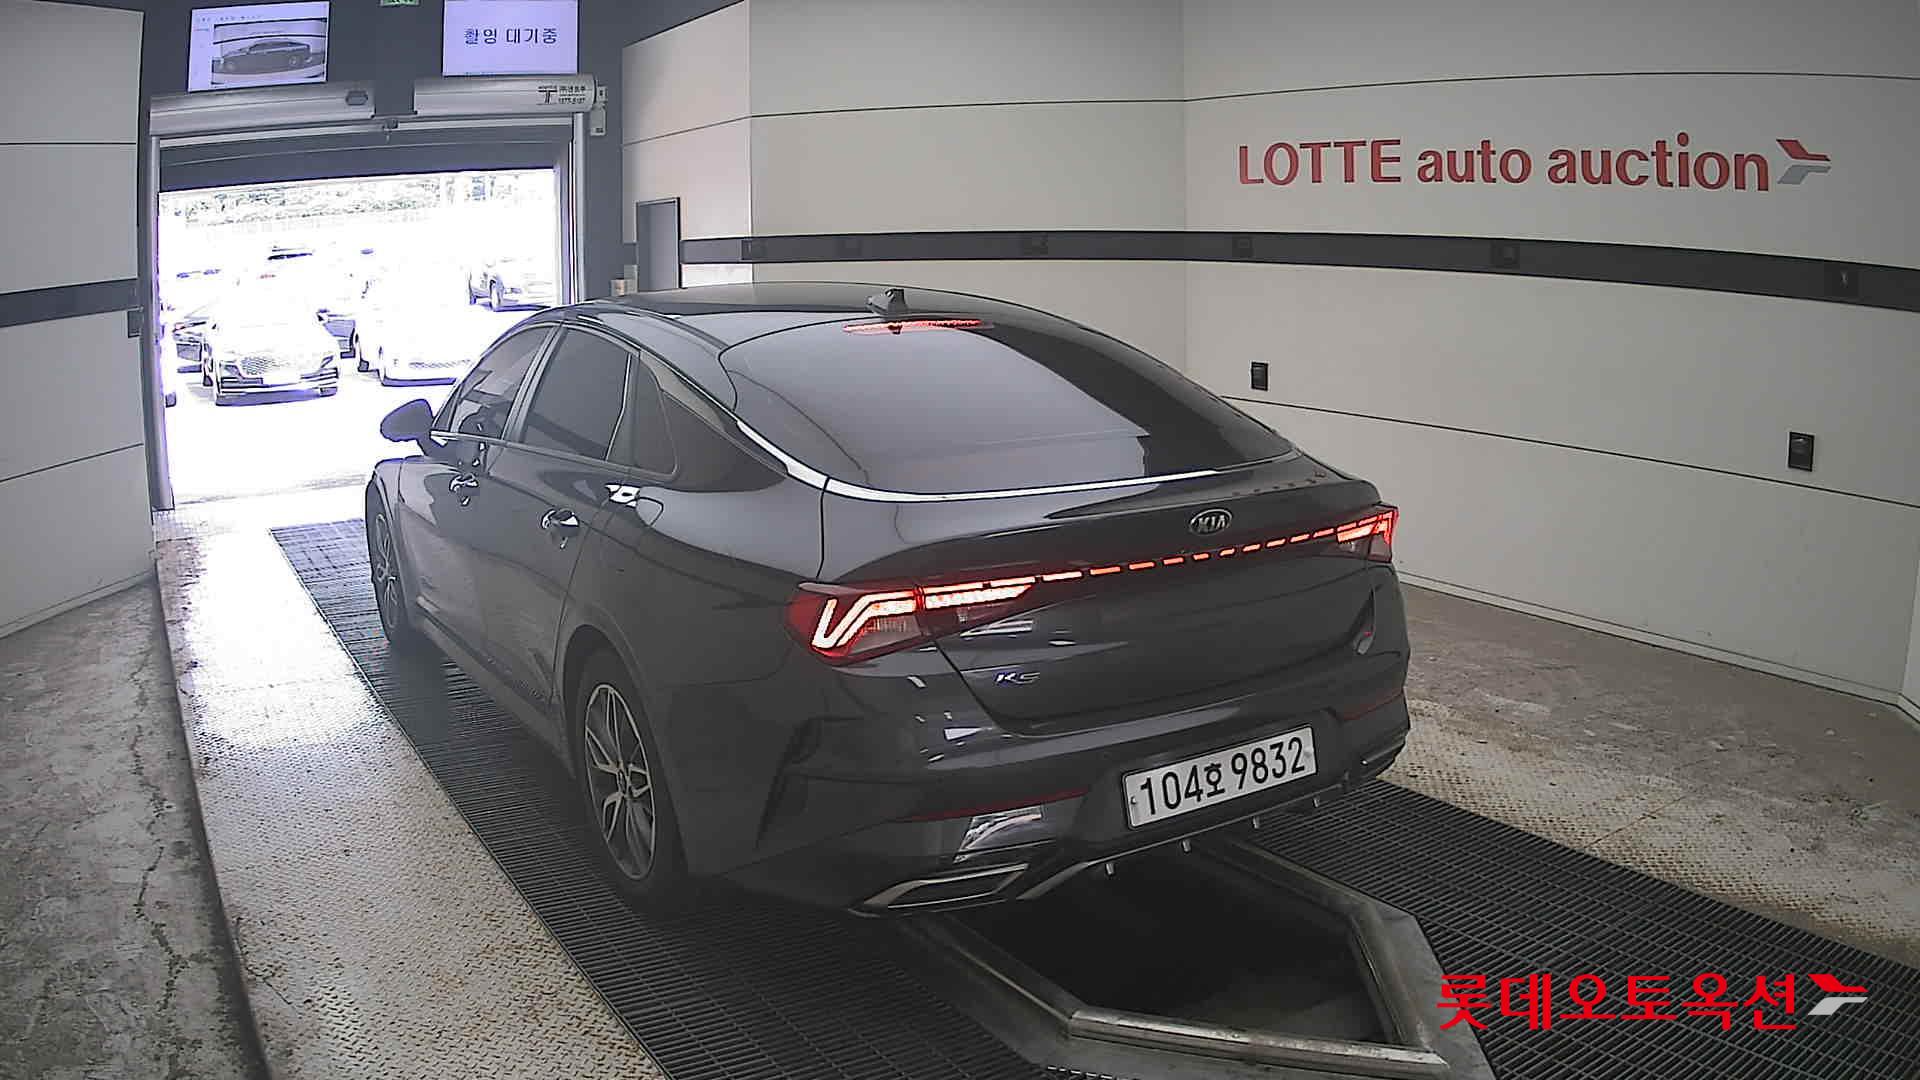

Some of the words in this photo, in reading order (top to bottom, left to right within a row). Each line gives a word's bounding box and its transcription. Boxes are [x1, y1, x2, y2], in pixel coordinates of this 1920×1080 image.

[505, 27, 558, 45] 대기중
[1239, 139, 1402, 186] LOTTE
[1416, 139, 1533, 184] auto
[1547, 131, 1769, 192] auction
[1196, 512, 1230, 534] KIA
[995, 671, 1041, 686] K5
[1140, 762, 1226, 815] 104호
[1230, 736, 1306, 790] 9832
